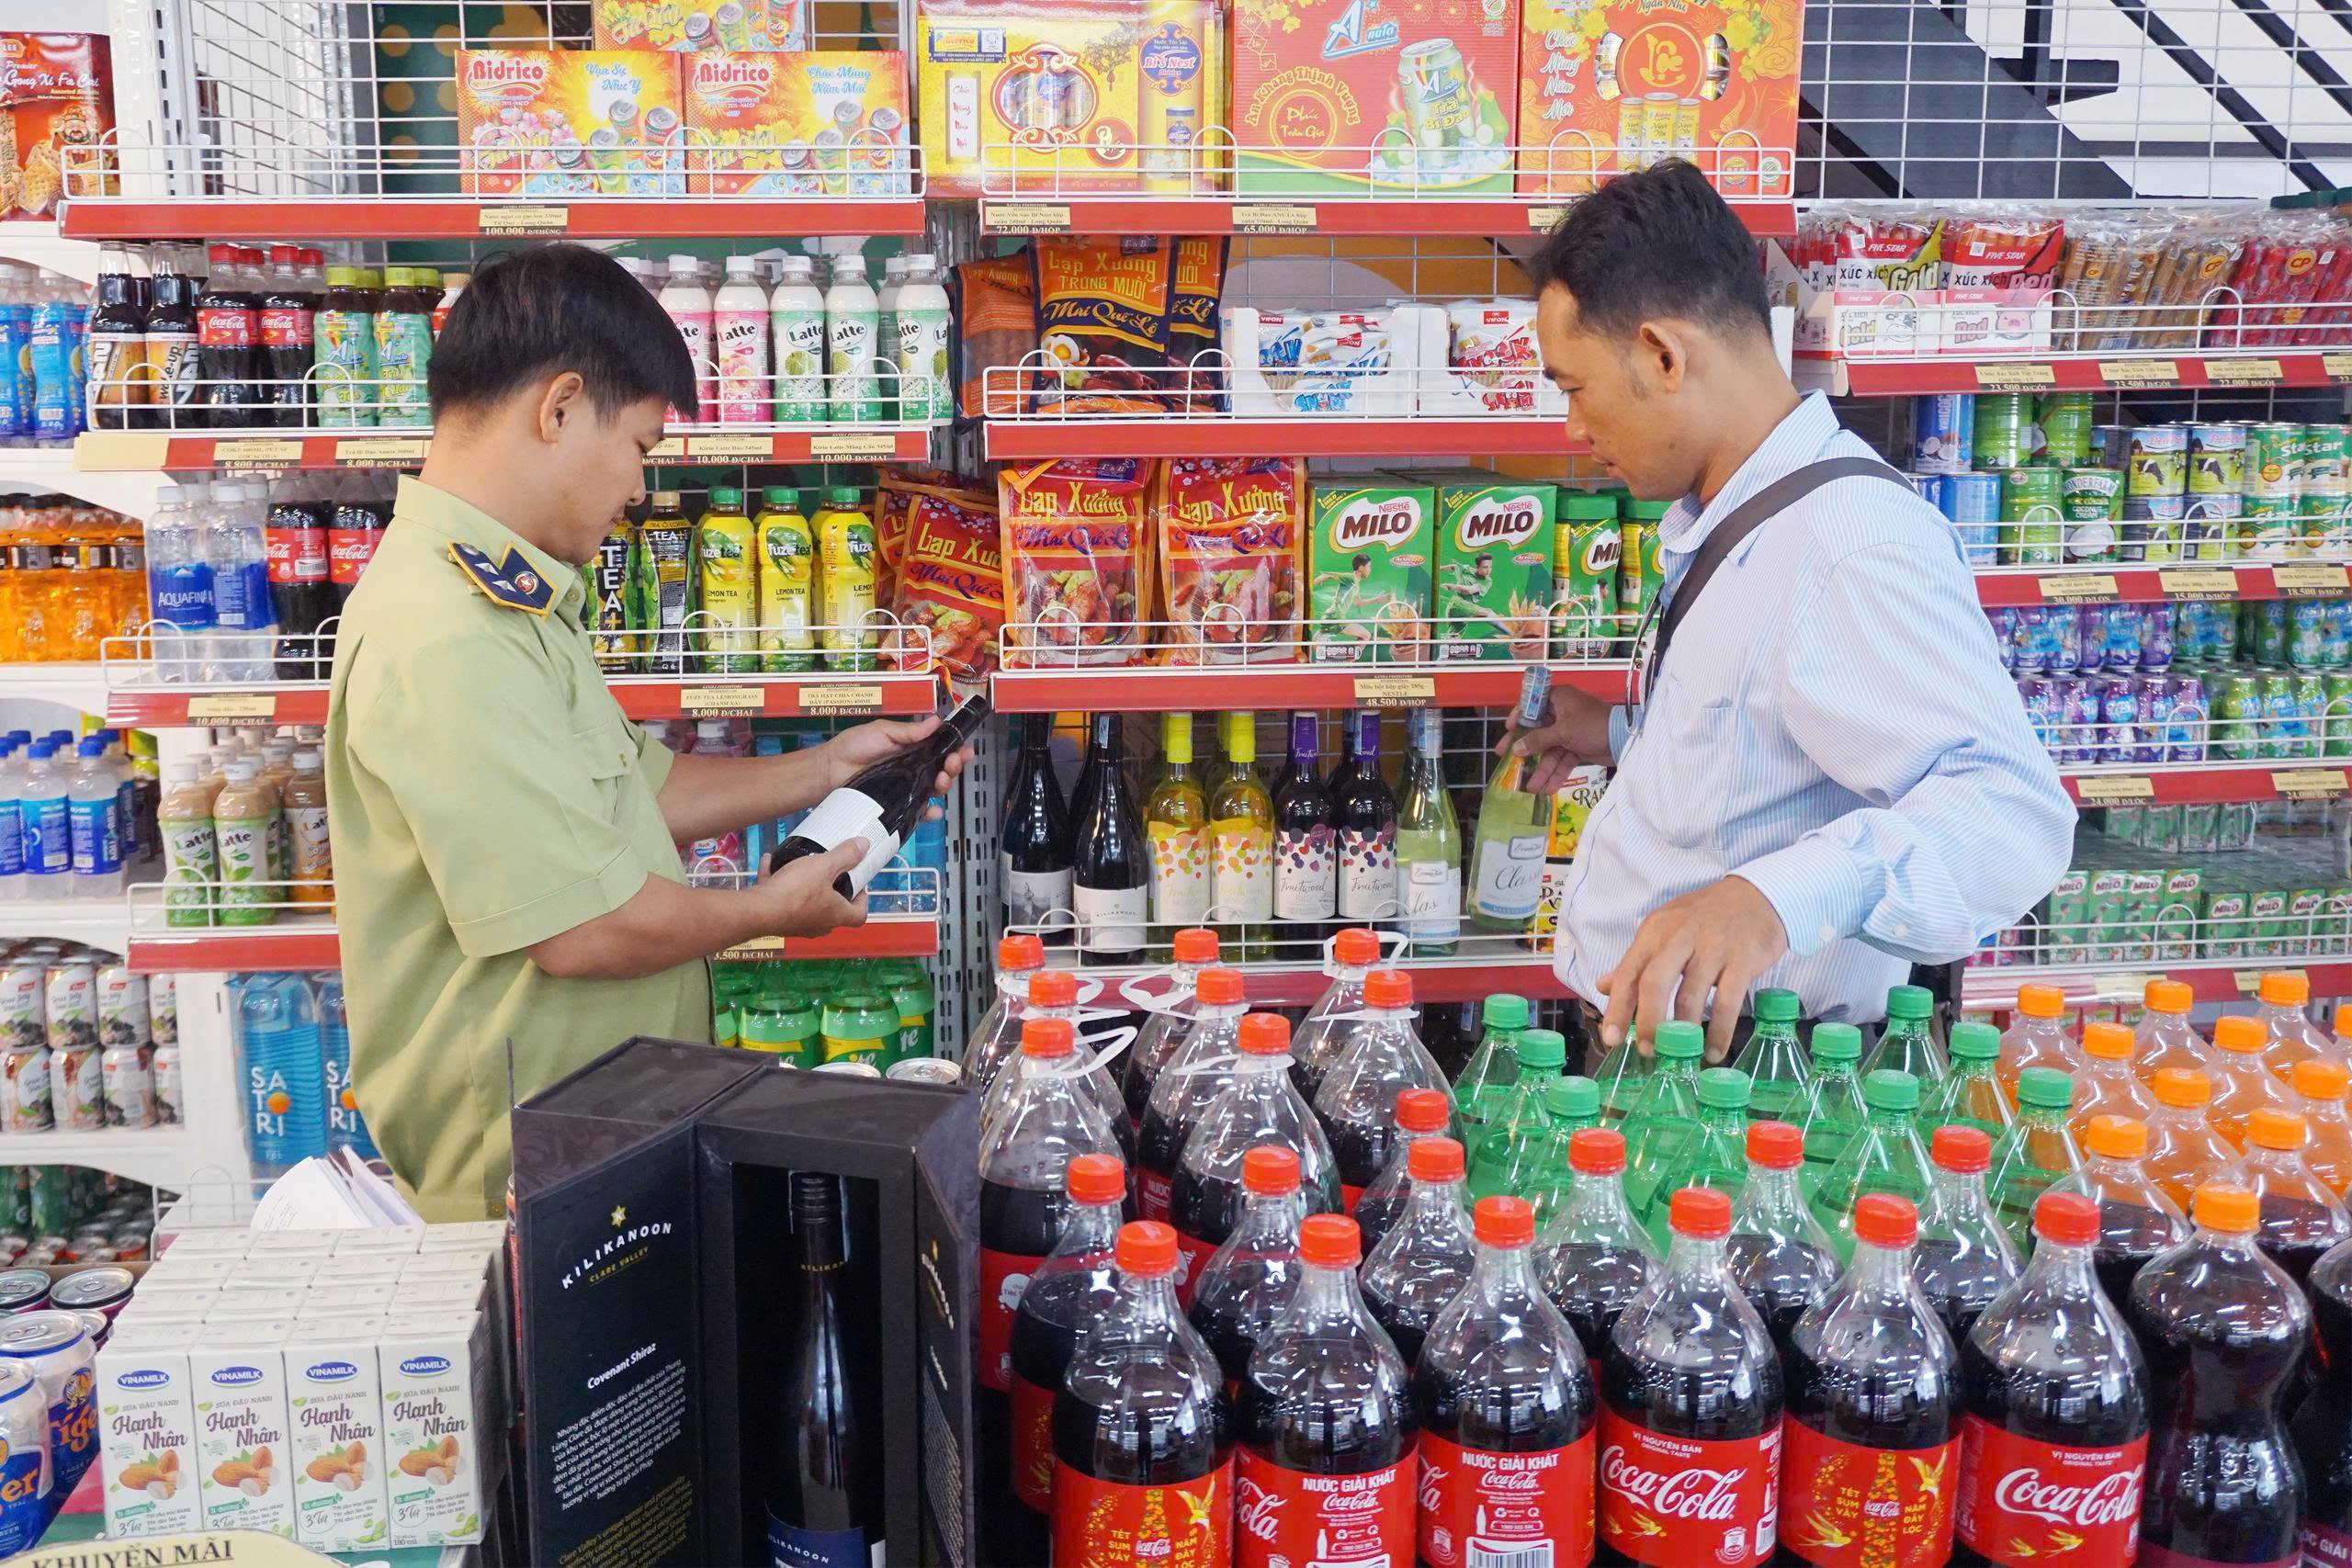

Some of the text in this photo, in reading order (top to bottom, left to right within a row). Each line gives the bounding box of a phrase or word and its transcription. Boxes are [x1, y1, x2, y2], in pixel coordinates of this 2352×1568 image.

[472, 60, 544, 81] Bidrico
[699, 62, 770, 83] Bidrico
[58, 73, 75, 86] Fa
[1254, 69, 1294, 110] Khang
[1294, 65, 1336, 89] Thịnh
[1430, 96, 1459, 116] Trà
[485, 227, 528, 236] 100.000
[996, 225, 1029, 234] 72.000
[1244, 225, 1276, 233] 65.000
[1867, 243, 1906, 253] FIVE STAR
[1985, 252, 2026, 260] FIVE STAR
[1048, 252, 1157, 282] Lạp Xưởng
[2204, 260, 2222, 273] CP
[2290, 256, 2311, 267] CP
[209, 315, 247, 329] Coca-Cola
[261, 315, 292, 329] Coca-Cola
[1044, 300, 1132, 328] Mai Quế
[718, 323, 758, 342] Latte
[788, 324, 823, 343] Latte
[2220, 378, 2249, 387] 22.000
[224, 460, 253, 468] 8.800
[346, 459, 374, 468] 8.000
[696, 456, 729, 464] 10.000
[820, 454, 853, 462] 10.000
[1019, 481, 1129, 524] Lạp Xưởng
[1177, 491, 1214, 525] Lạp
[1221, 481, 1288, 525] Xưởng
[1378, 502, 1411, 513] Nestlé
[1503, 501, 1533, 512] Nestlé
[1341, 512, 1412, 540] MILO
[1467, 511, 1534, 538] MILO
[917, 523, 956, 561] Lạp
[1015, 525, 1064, 547] Mai
[331, 543, 370, 558] Coca-Cola
[1591, 540, 1620, 561] MIL
[158, 590, 212, 608] AQUAFINA
[2287, 588, 2316, 596] 18.500
[1366, 698, 1397, 707] 48.500
[692, 708, 753, 717] 8.000 Đ/CHAI
[809, 706, 872, 716] 8.000 Đ/CHAI
[196, 716, 229, 726] 10.000
[174, 830, 213, 850] Latte
[219, 830, 253, 848] Latte
[1281, 876, 1328, 893] Fruitwood
[2057, 881, 2084, 892] MILO
[2095, 879, 2121, 890] MILO
[2132, 879, 2159, 890] MILO
[2170, 878, 2196, 889] MILO
[2214, 902, 2240, 912] MILO
[2256, 900, 2280, 912] MILO
[2293, 898, 2318, 910] MILO
[742, 951, 774, 960] Đ/CHAI
[561, 1222, 673, 1290] KILIKANOON
[308, 1365, 356, 1376] VINAMILK
[401, 1359, 447, 1371] VINAMILK
[586, 1342, 657, 1390] Covenant Shiraz
[120, 1374, 168, 1384] VINAMILK
[213, 1371, 262, 1382] VINAMILK
[300, 1403, 354, 1427] Hạnh
[393, 1397, 447, 1422] Hạnh
[112, 1411, 166, 1436] Hạnh
[206, 1407, 260, 1432] Hạnh
[423, 1416, 469, 1437] Nhân
[143, 1430, 188, 1450] Nhân
[236, 1427, 282, 1448] Nhân
[330, 1423, 376, 1443] Nhân
[1462, 1451, 1559, 1470] NƯỚC GIẢI KHÁT
[1302, 1468, 1396, 1492] NƯỚC GIẢI KHÁT
[1481, 1470, 1541, 1489] Coca-Cola
[1600, 1445, 1747, 1520] Coca-Cola
[1323, 1488, 1380, 1511] Coca-Cola
[1837, 1497, 1860, 1508] SUM
[1995, 1463, 2144, 1526] Coca-Cola
[1863, 1500, 1901, 1517] Coca-Cola
[1111, 1529, 1131, 1540] TẾT
[175, 1537, 233, 1562] MÃI
[1108, 1540, 1131, 1551] SUM
[1135, 1539, 1171, 1556] Coca-Cola
